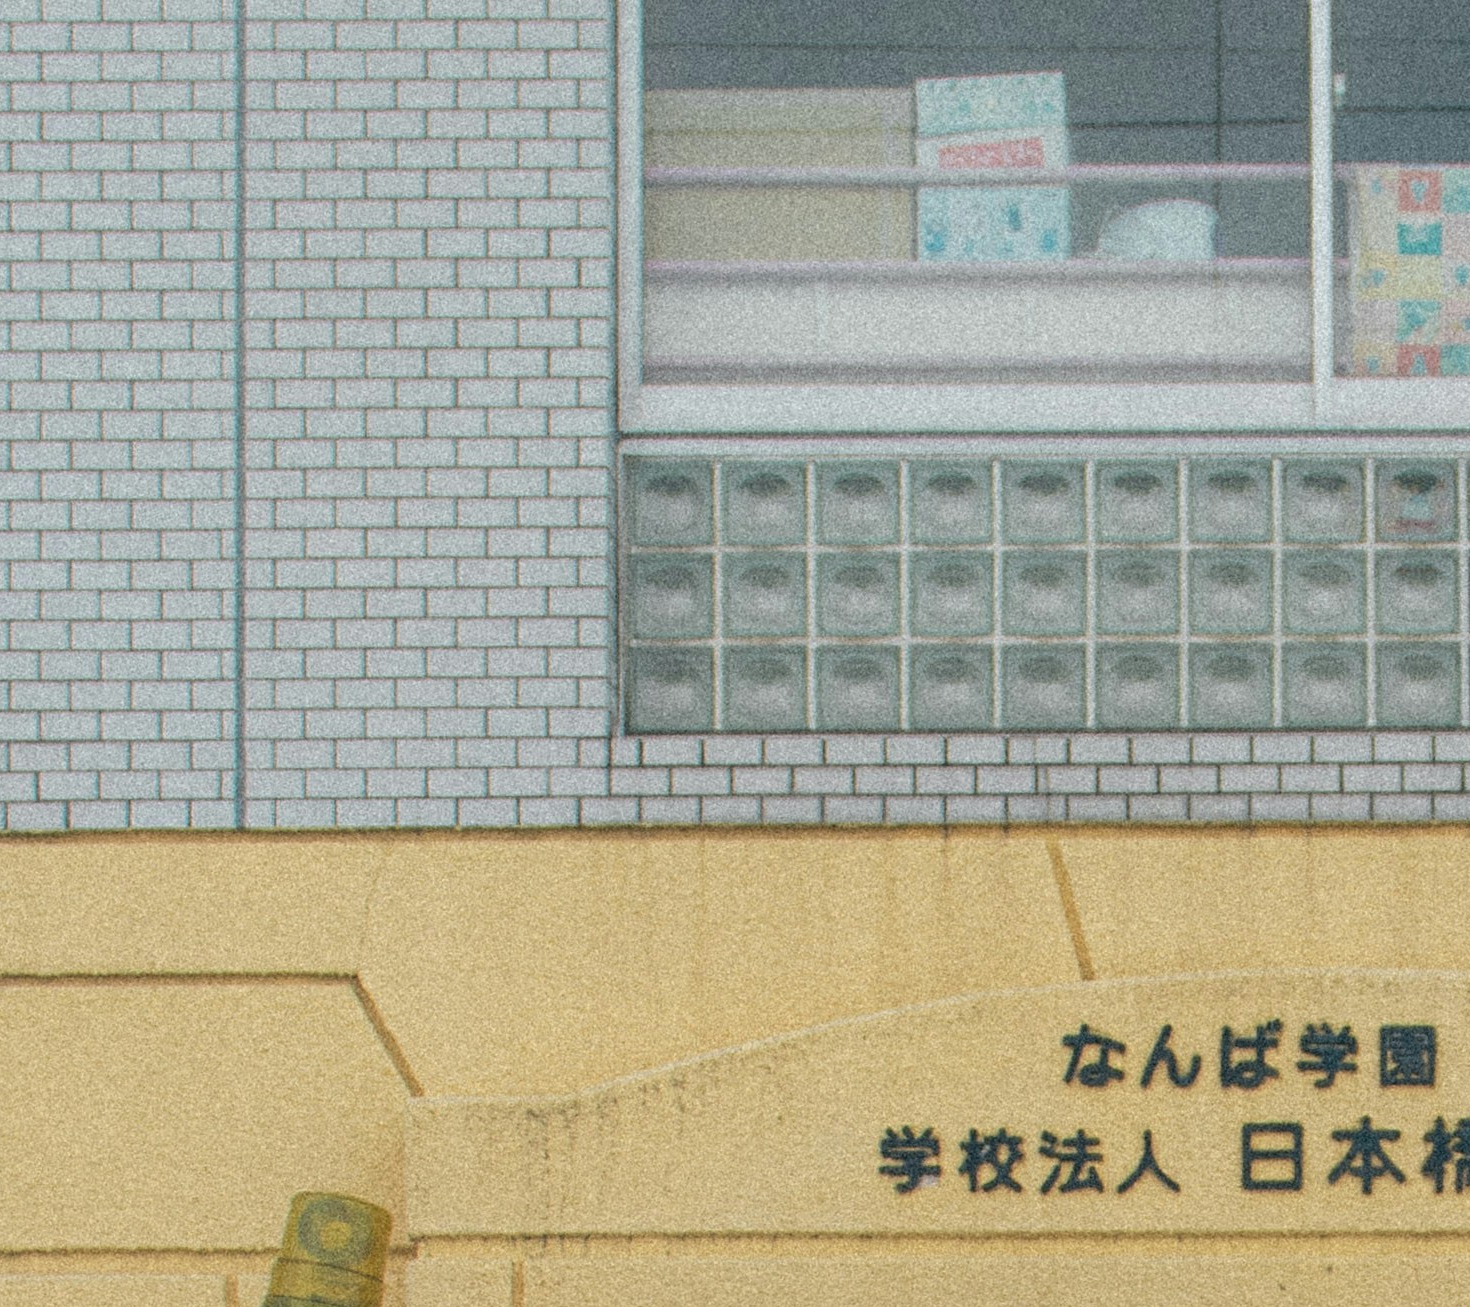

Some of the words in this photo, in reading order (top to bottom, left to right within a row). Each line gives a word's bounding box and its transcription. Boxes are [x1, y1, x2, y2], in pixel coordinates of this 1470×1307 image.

[1062, 1018, 1438, 1089] なんば学園
[878, 1125, 1183, 1196] 学校法人
